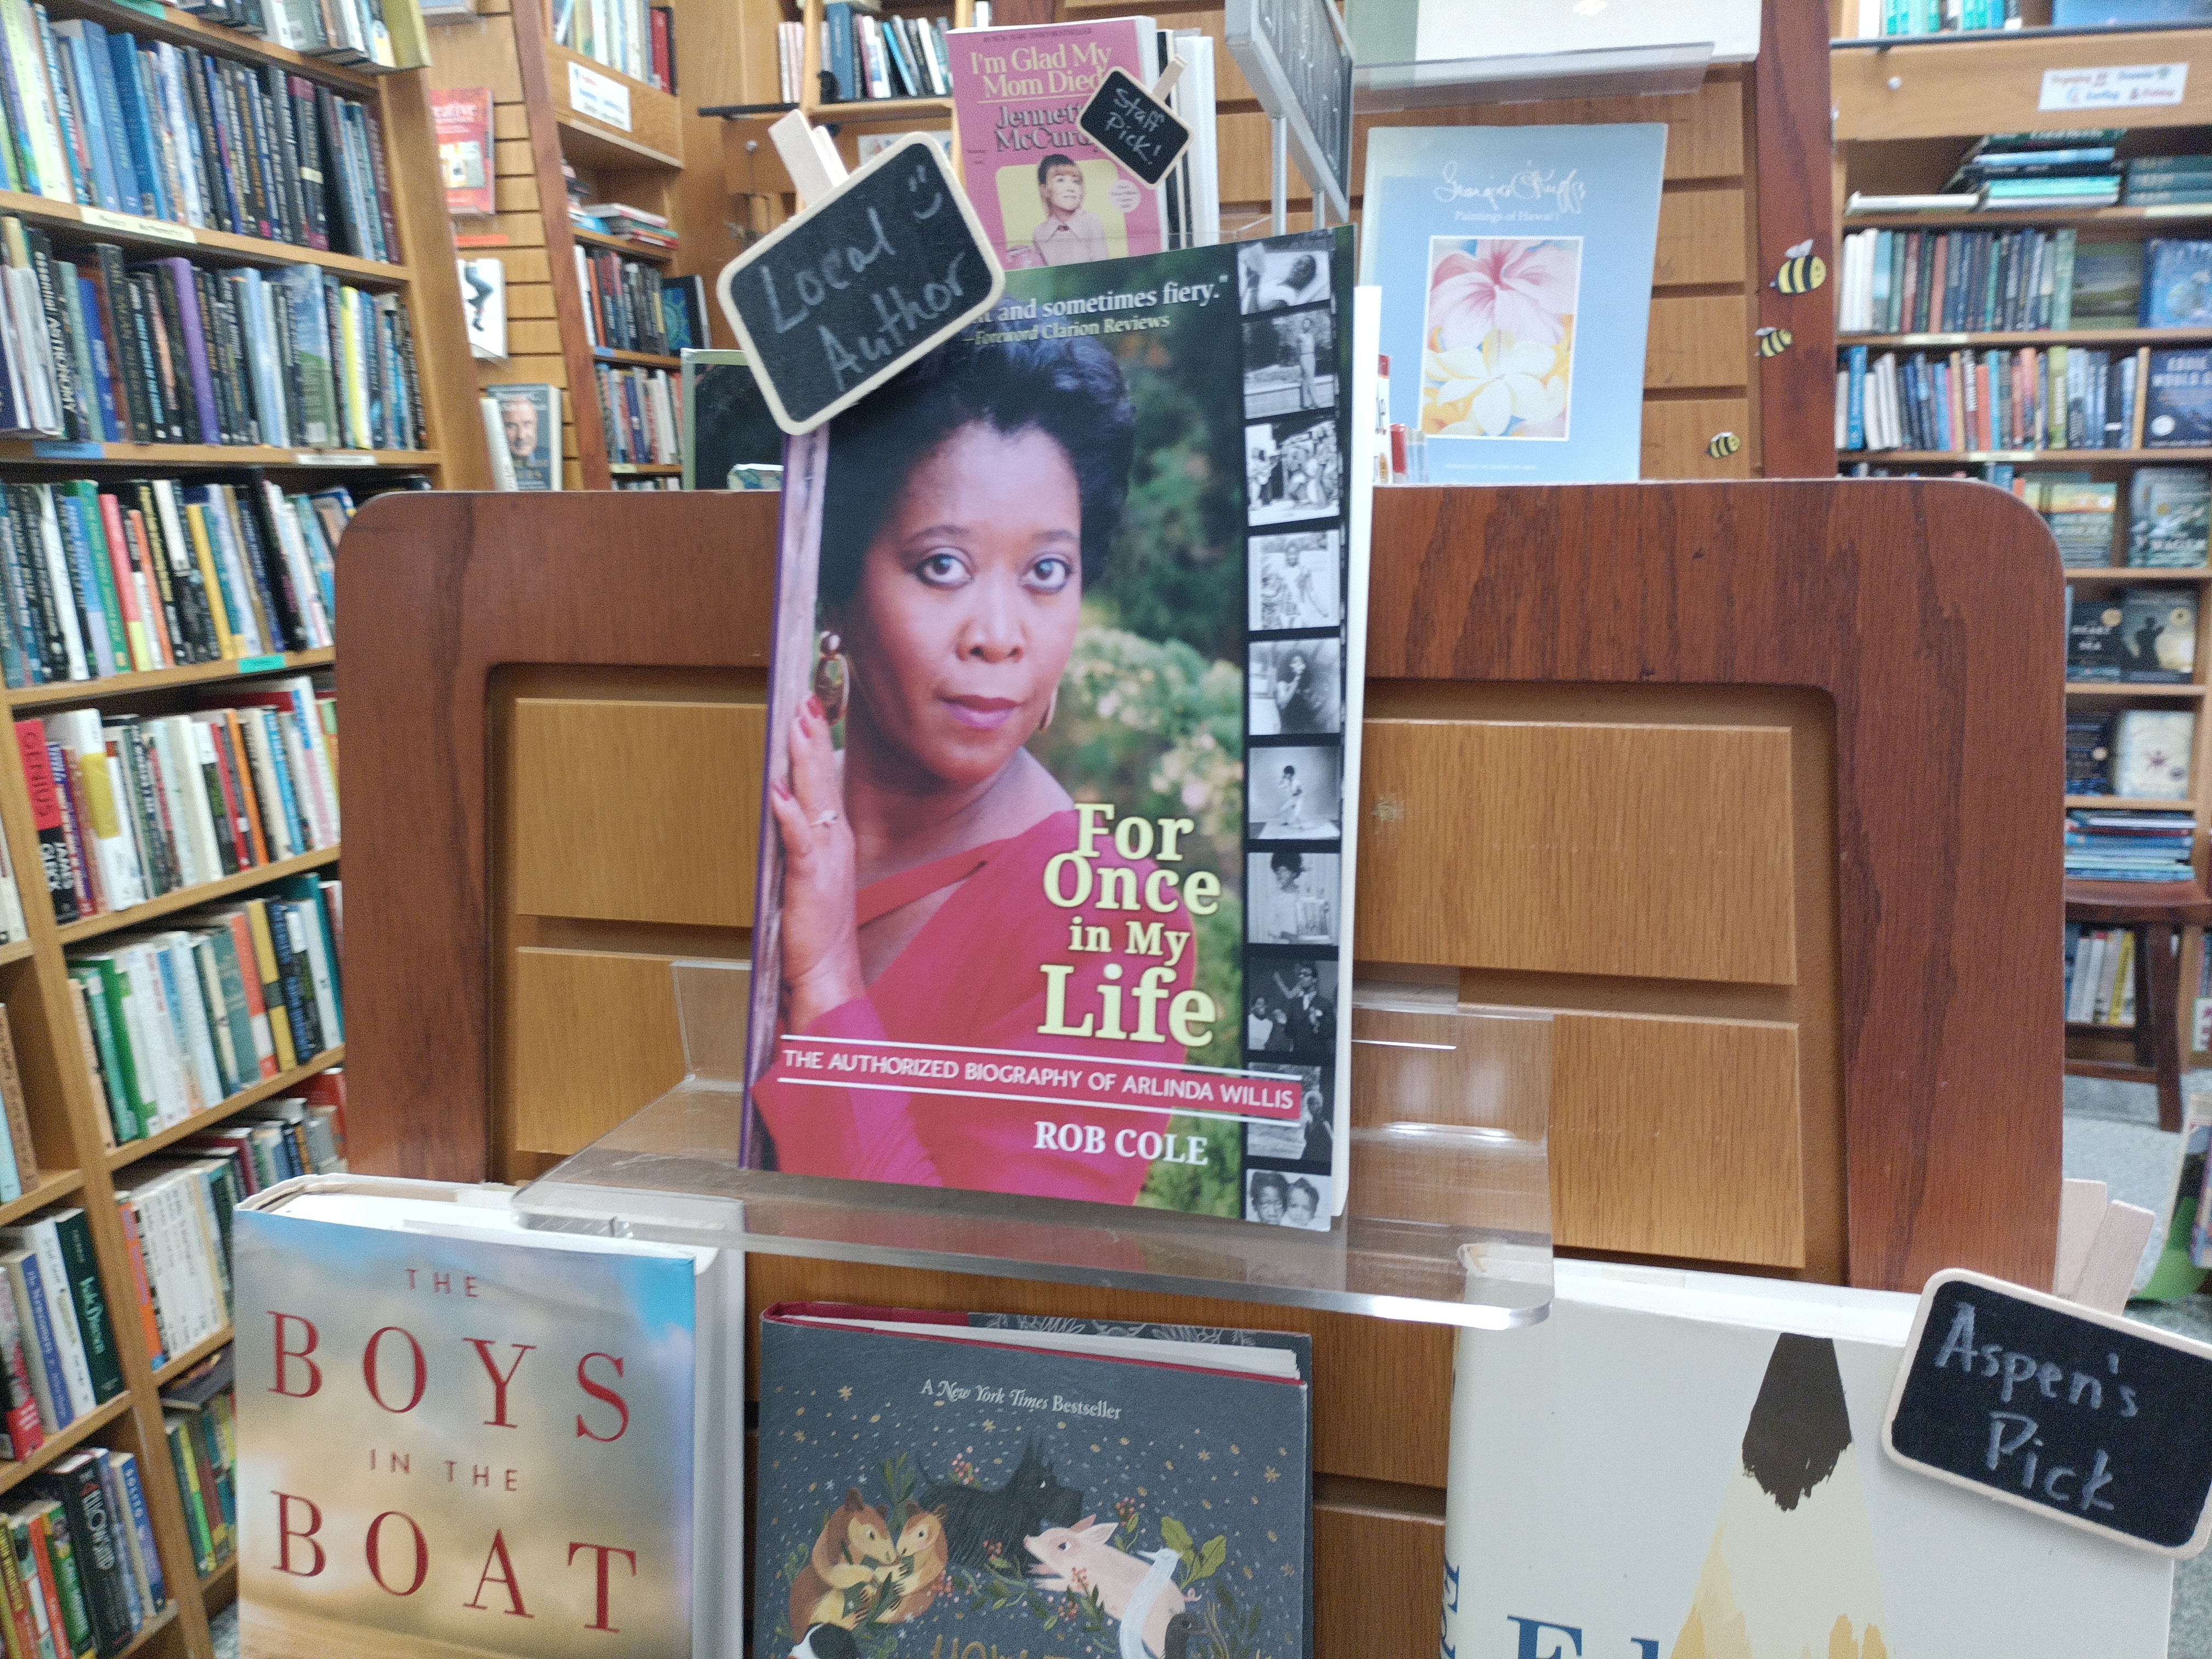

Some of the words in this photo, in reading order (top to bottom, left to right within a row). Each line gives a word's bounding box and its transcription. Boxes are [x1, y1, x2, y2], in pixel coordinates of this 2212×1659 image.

[969, 51, 1007, 75] I'm
[1011, 43, 1067, 72] Glad
[1071, 42, 1112, 76] My
[984, 74, 1043, 98] Mom
[996, 102, 1085, 129] Jennet
[1113, 88, 1165, 132] Staff
[1105, 111, 1162, 166] Pick!
[759, 206, 896, 332] Local
[815, 251, 967, 393] Author
[997, 298, 1037, 321] and
[1042, 289, 1158, 318] sometimes
[1042, 320, 1100, 339] Clarion
[1103, 313, 1170, 334] Reviews
[24, 732, 52, 817] GENIUS
[1074, 803, 1194, 861] For
[1043, 852, 1222, 915] Once
[1068, 916, 1111, 952] in
[1125, 921, 1191, 967] My
[1037, 963, 1216, 1047] Life
[782, 1049, 824, 1070] THE
[828, 1053, 960, 1080] AUTHORIZED
[964, 1062, 1083, 1089] BIOGRAPHY
[1087, 1071, 1117, 1092] OF
[1121, 1077, 1215, 1103] ARLINDA
[1220, 1084, 1294, 1110] WILLIS
[1034, 1120, 1106, 1154] ROB
[1114, 1130, 1209, 1166] COLE
[403, 1268, 479, 1299] THE
[266, 1310, 630, 1443] BOYS
[1933, 1298, 2138, 1419] Aspen's
[919, 1378, 934, 1395] A
[936, 1380, 971, 1402] New
[975, 1384, 1005, 1404] York
[1009, 1388, 1049, 1410] Times
[1052, 1394, 1122, 1420] Bestseller
[369, 1448, 410, 1474] IN
[444, 1459, 518, 1492] THE
[1984, 1409, 2115, 1513] Pick
[269, 1489, 637, 1634] BOAT
